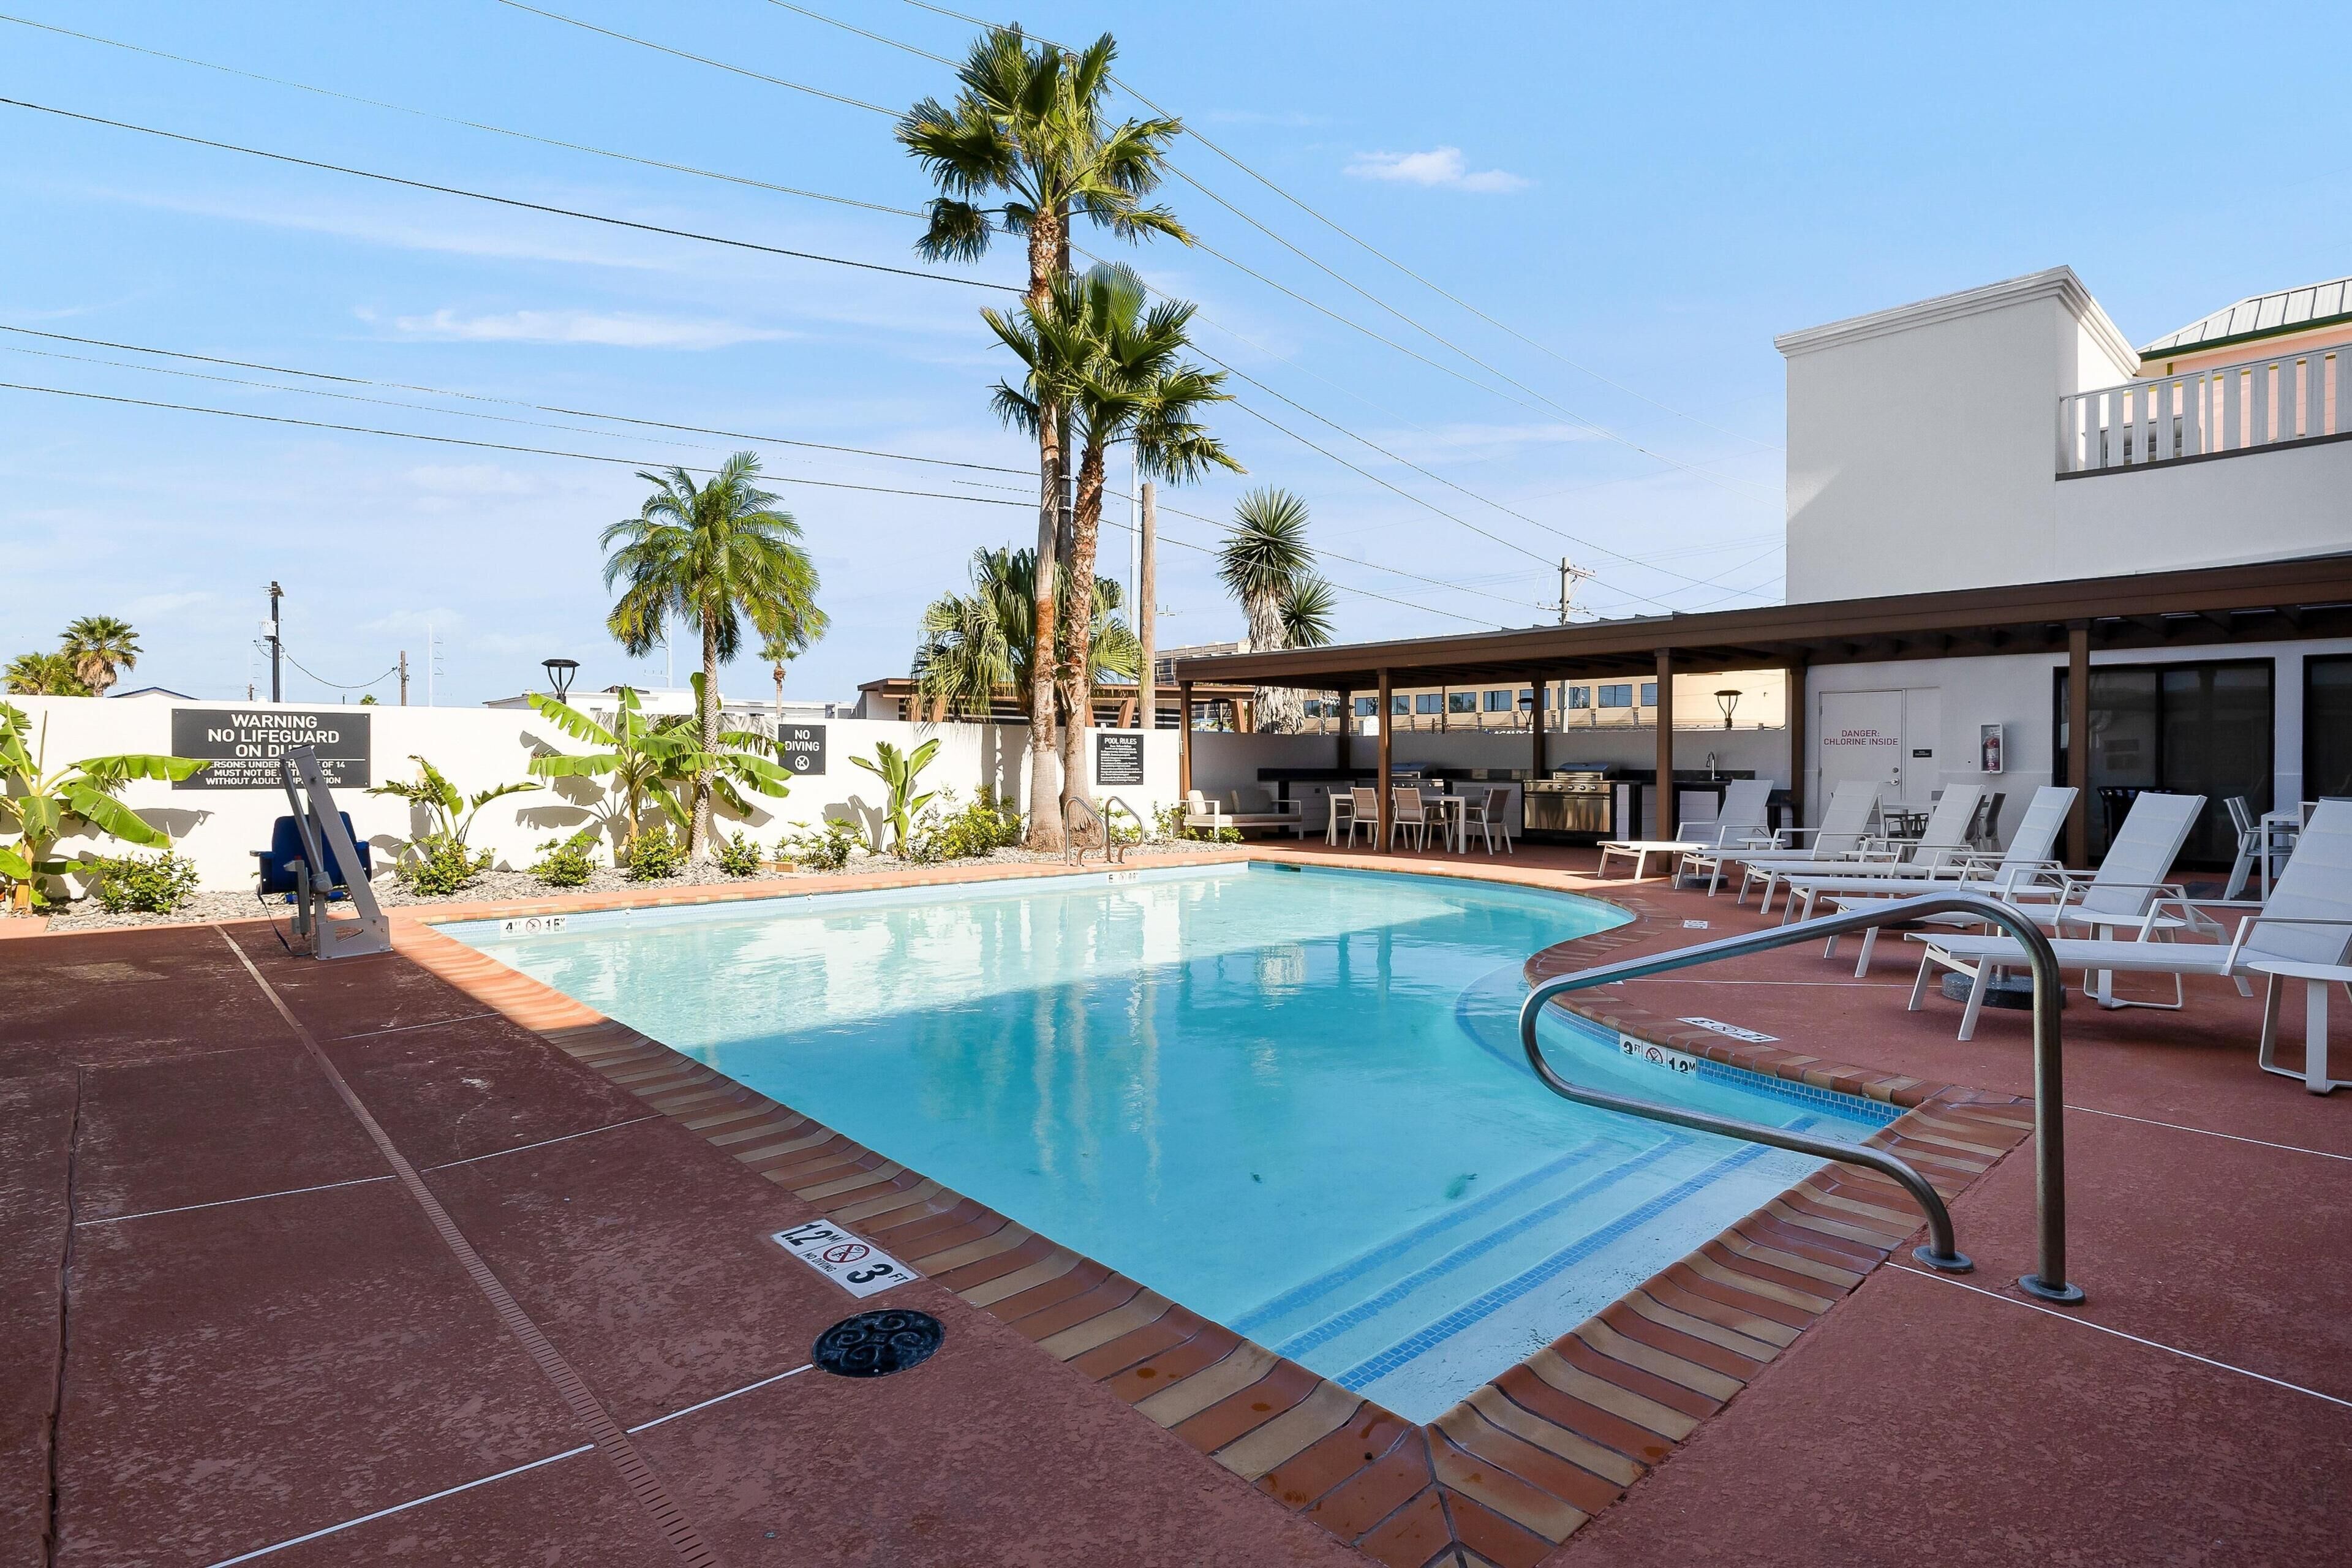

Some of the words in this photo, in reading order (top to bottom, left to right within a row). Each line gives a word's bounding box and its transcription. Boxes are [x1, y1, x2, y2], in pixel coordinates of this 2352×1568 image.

[231, 714, 317, 728] WARNING
[208, 729, 235, 742] NO
[241, 729, 339, 743] LIFEGUARD
[794, 729, 810, 740] NO
[236, 744, 262, 757] ON
[785, 741, 820, 752] DIVING
[1634, 1044, 1641, 1053] FT
[1689, 1061, 1695, 1071] M
[780, 1224, 834, 1246] 1.2
[811, 1258, 837, 1272] DIVING
[846, 1264, 894, 1284] 3
[888, 1272, 909, 1283] FT
